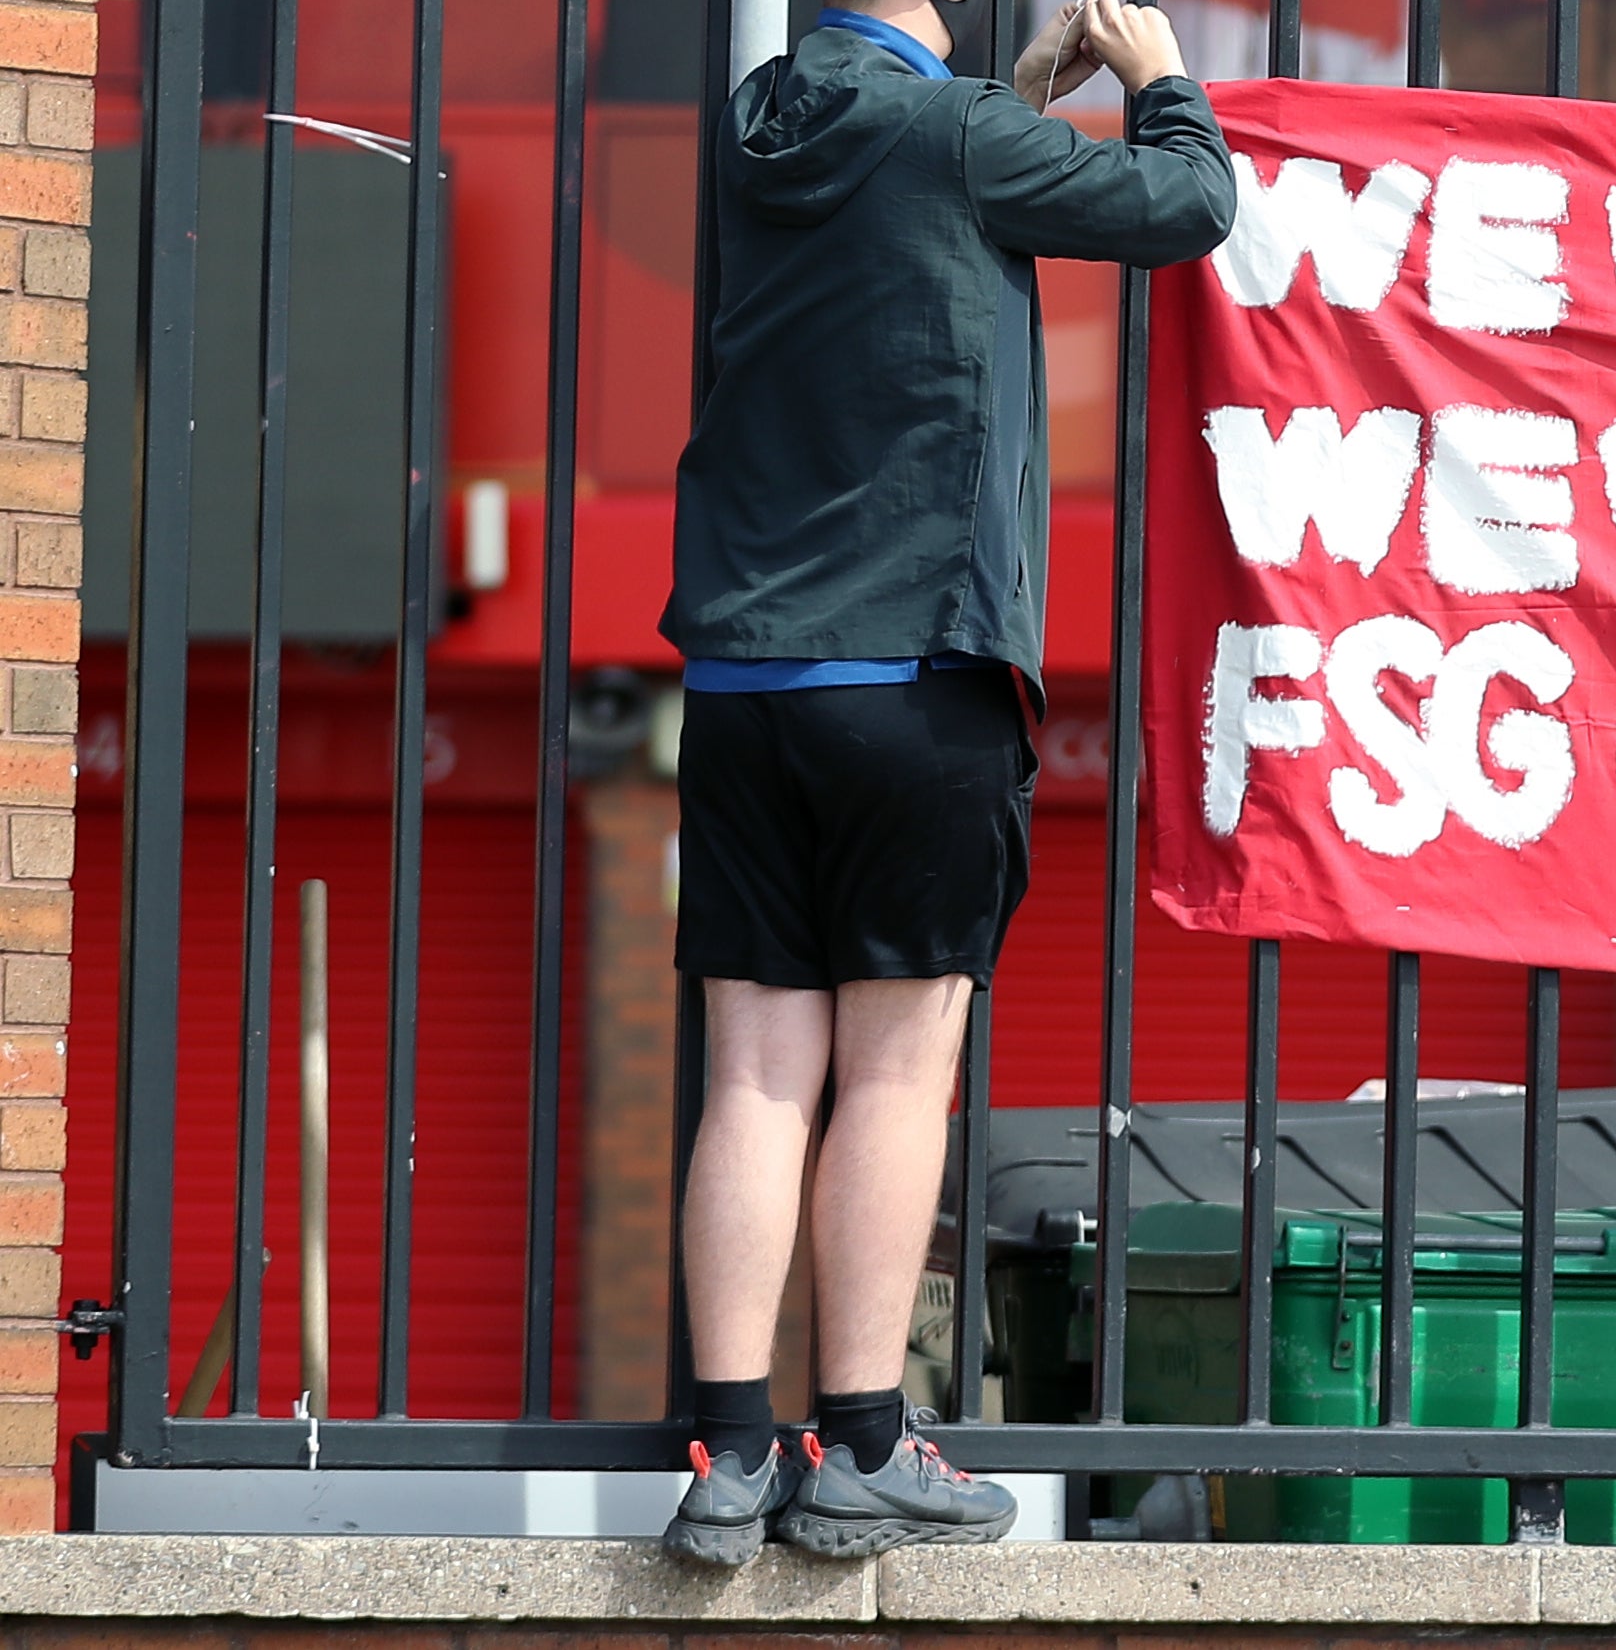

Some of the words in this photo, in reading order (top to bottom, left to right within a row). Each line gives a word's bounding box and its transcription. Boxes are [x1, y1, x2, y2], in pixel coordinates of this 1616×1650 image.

[1211, 152, 1572, 337] WE
[1201, 402, 1580, 595] WE
[1202, 614, 1576, 859] FSG
